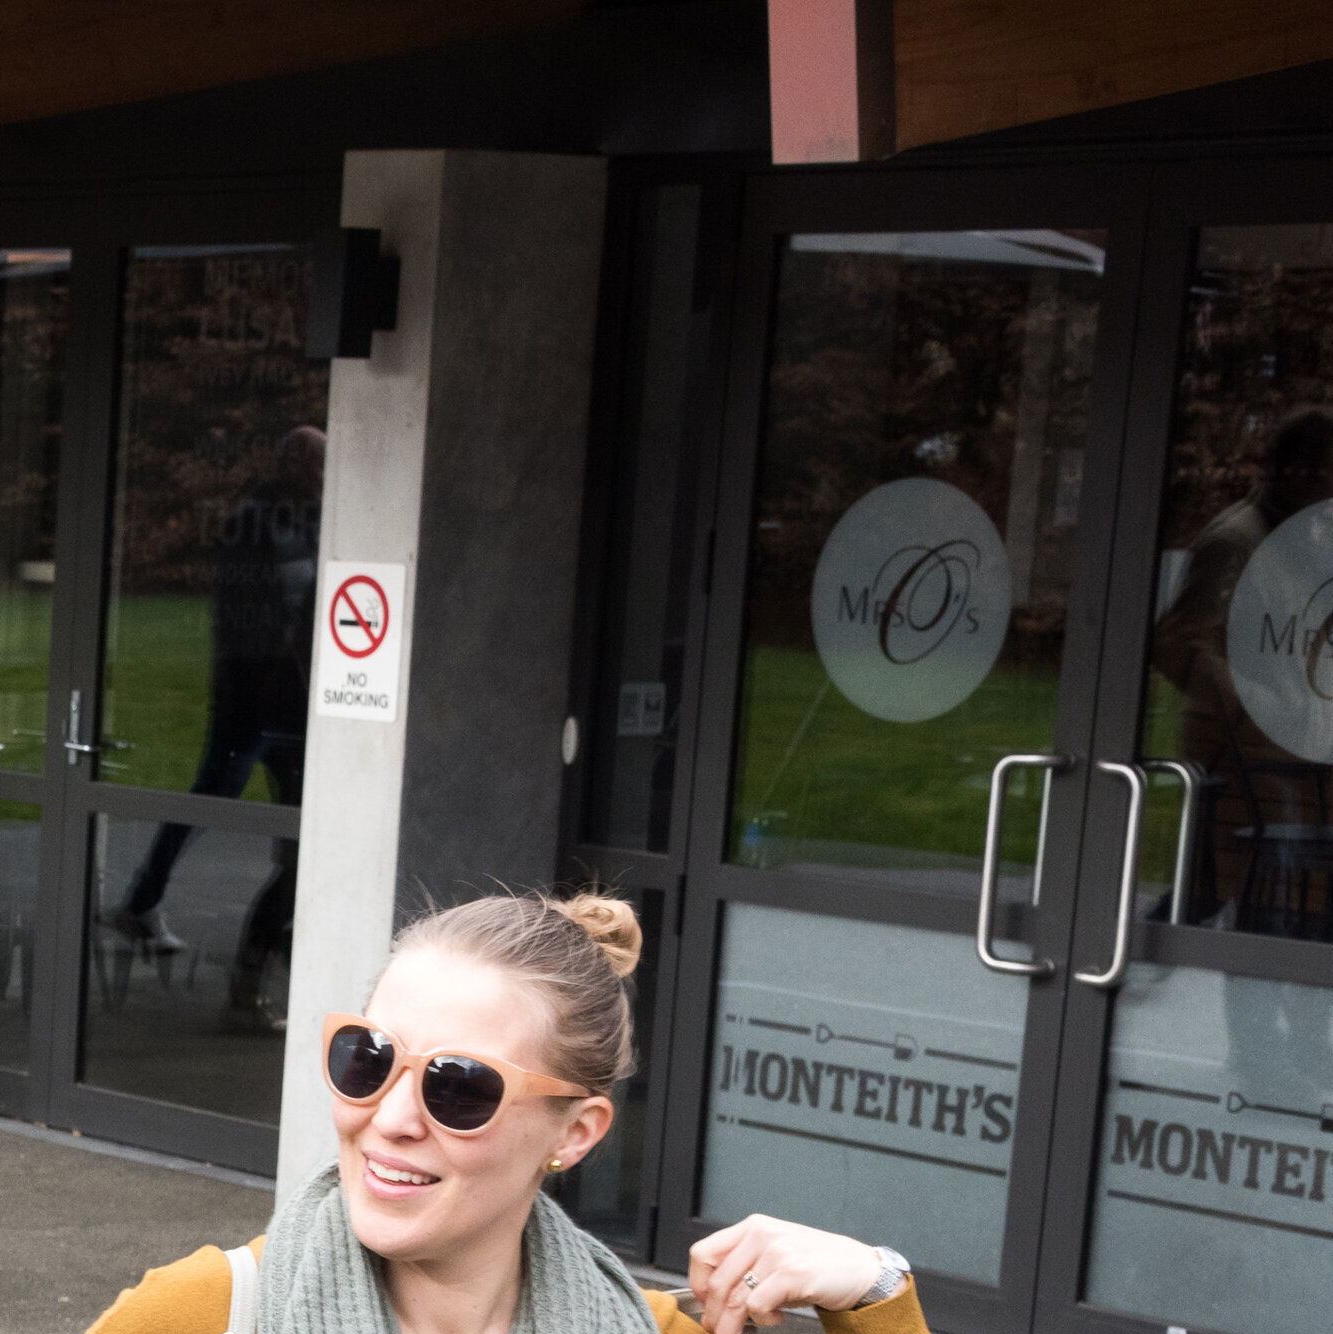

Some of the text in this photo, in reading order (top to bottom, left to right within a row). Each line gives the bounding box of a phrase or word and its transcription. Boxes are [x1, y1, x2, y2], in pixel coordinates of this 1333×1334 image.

[323, 690, 389, 709] SMOKING
[346, 672, 368, 688] NO
[720, 1044, 1013, 1144] MONTEITH'S
[1111, 1114, 1333, 1202] MONTEI
